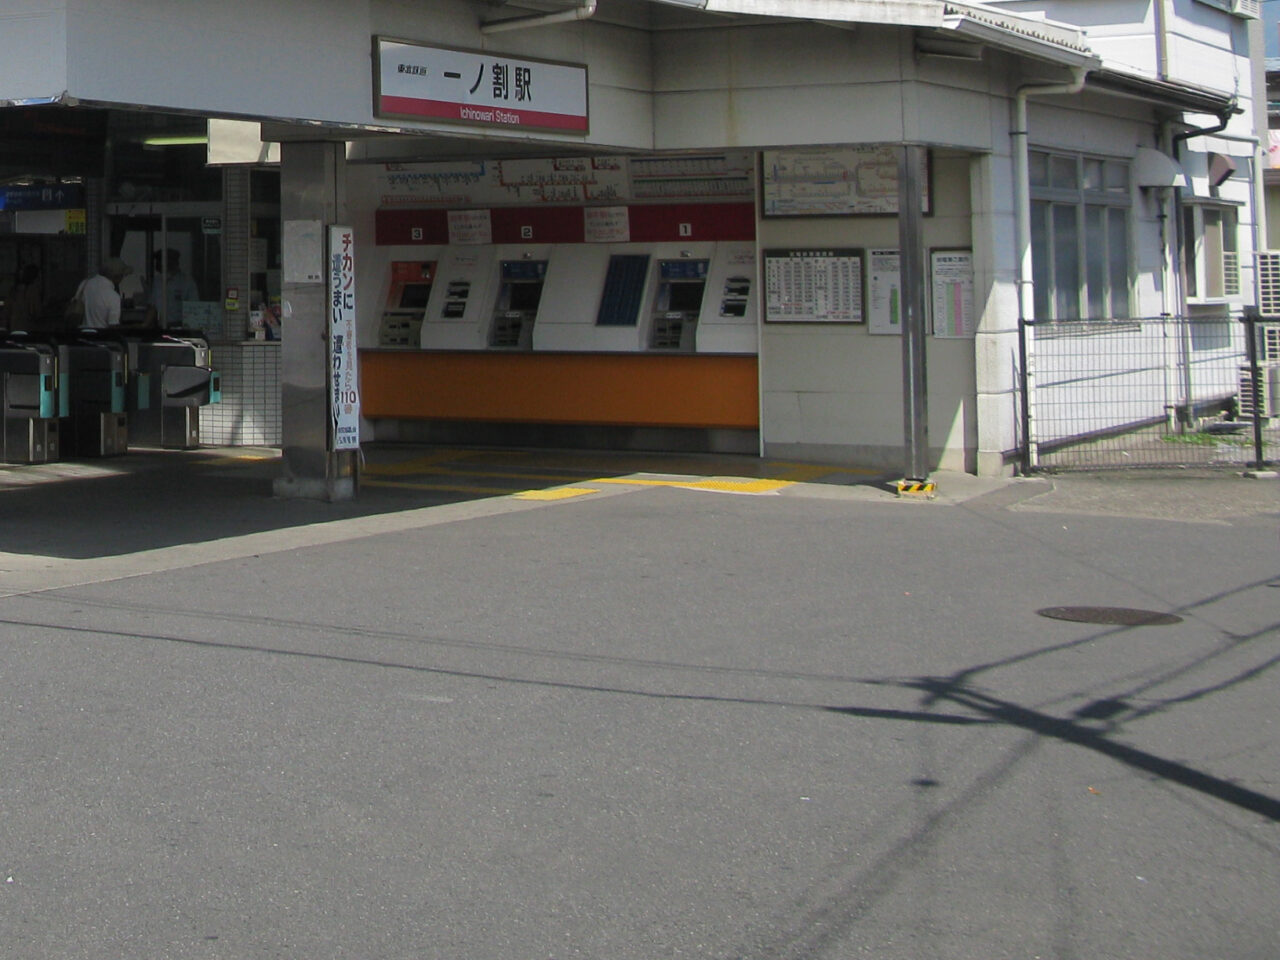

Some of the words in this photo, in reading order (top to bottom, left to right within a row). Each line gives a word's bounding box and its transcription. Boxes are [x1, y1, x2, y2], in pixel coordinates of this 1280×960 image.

[443, 62, 532, 102] 一ノ割駅
[460, 105, 495, 122] Ichinowari
[495, 107, 520, 125] Station
[413, 228, 421, 239] 3
[523, 227, 532, 238] 2
[342, 233, 354, 310] チカンに
